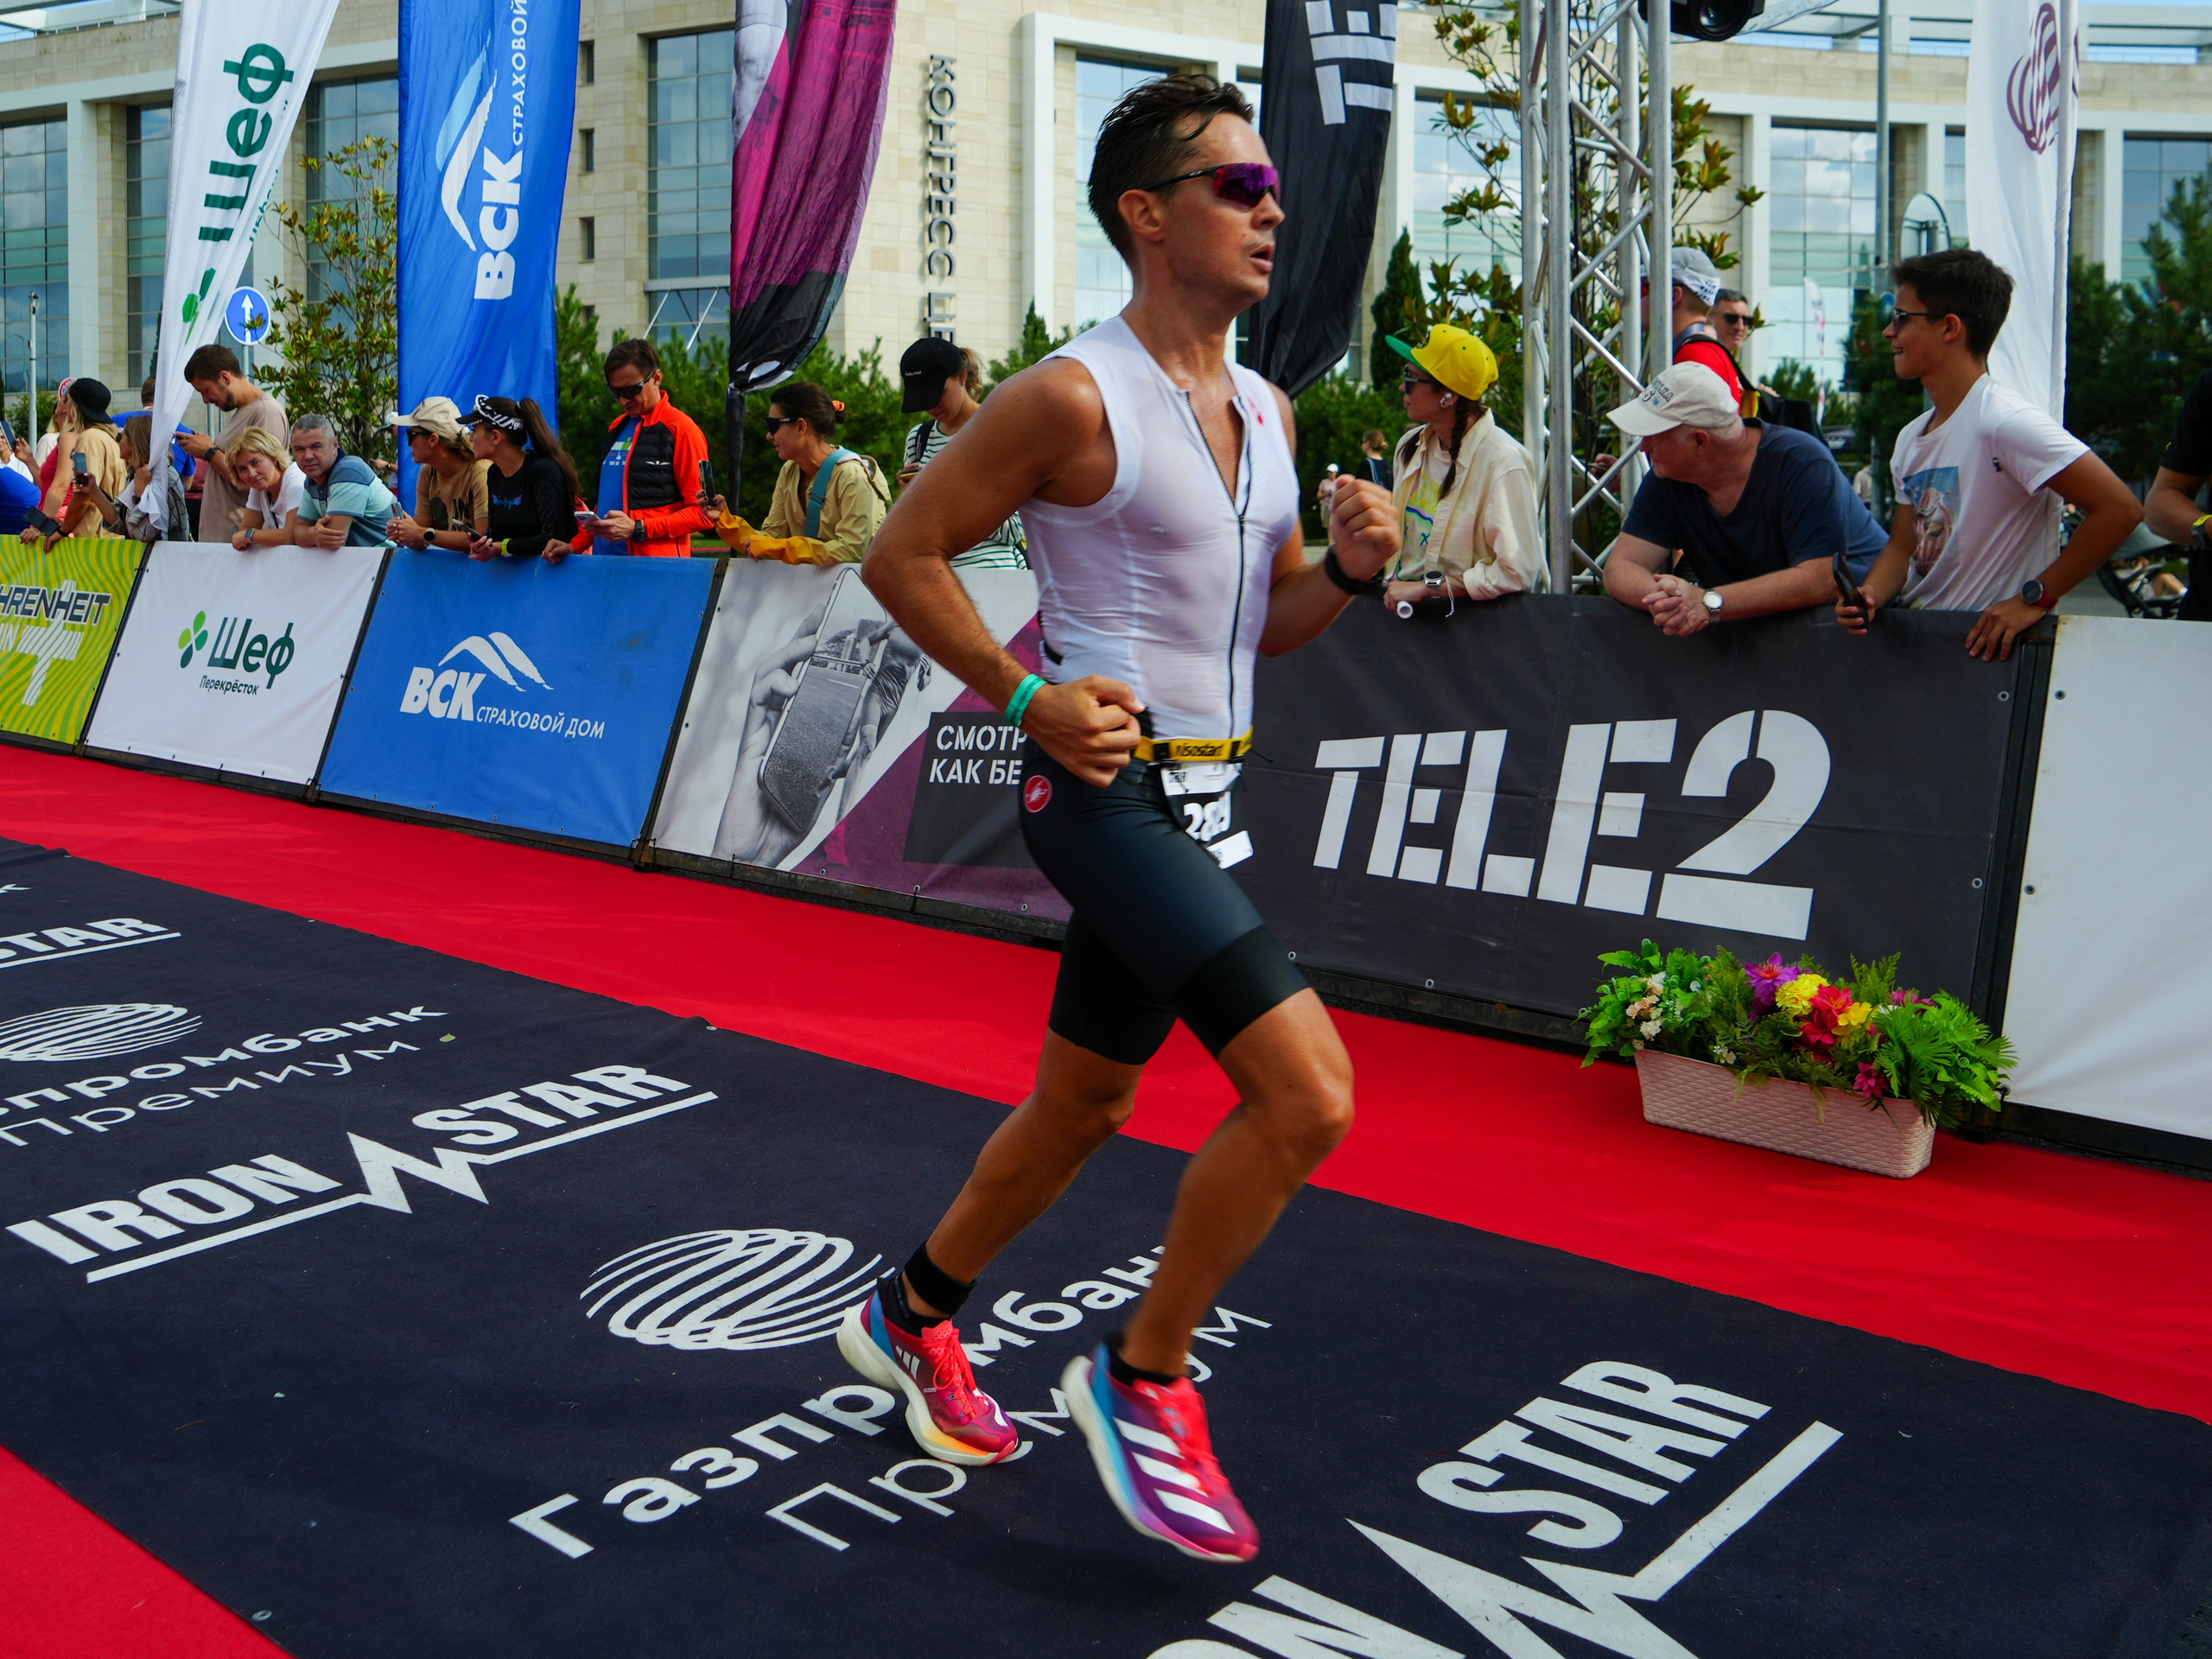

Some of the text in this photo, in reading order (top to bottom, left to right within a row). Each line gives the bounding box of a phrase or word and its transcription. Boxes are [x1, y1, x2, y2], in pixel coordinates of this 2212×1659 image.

[198, 43, 295, 242] Шеф
[928, 54, 957, 276] КОНГРЕСС
[474, 146, 524, 300] ВСК
[199, 674, 260, 696] Перекрёсток
[207, 616, 295, 690] Шеф
[399, 666, 606, 740] ВСК СТРАХОВОЙ ДОМ
[929, 758, 1023, 785] КАК БЕ
[1313, 709, 1832, 941] TELE2
[0, 1005, 449, 1116] промбанк
[0, 1039, 422, 1147] Премиум
[4, 1064, 692, 1266] IRON STAR
[508, 1244, 1166, 1560] Газпрмбан
[1416, 1359, 1773, 1550] STAR
